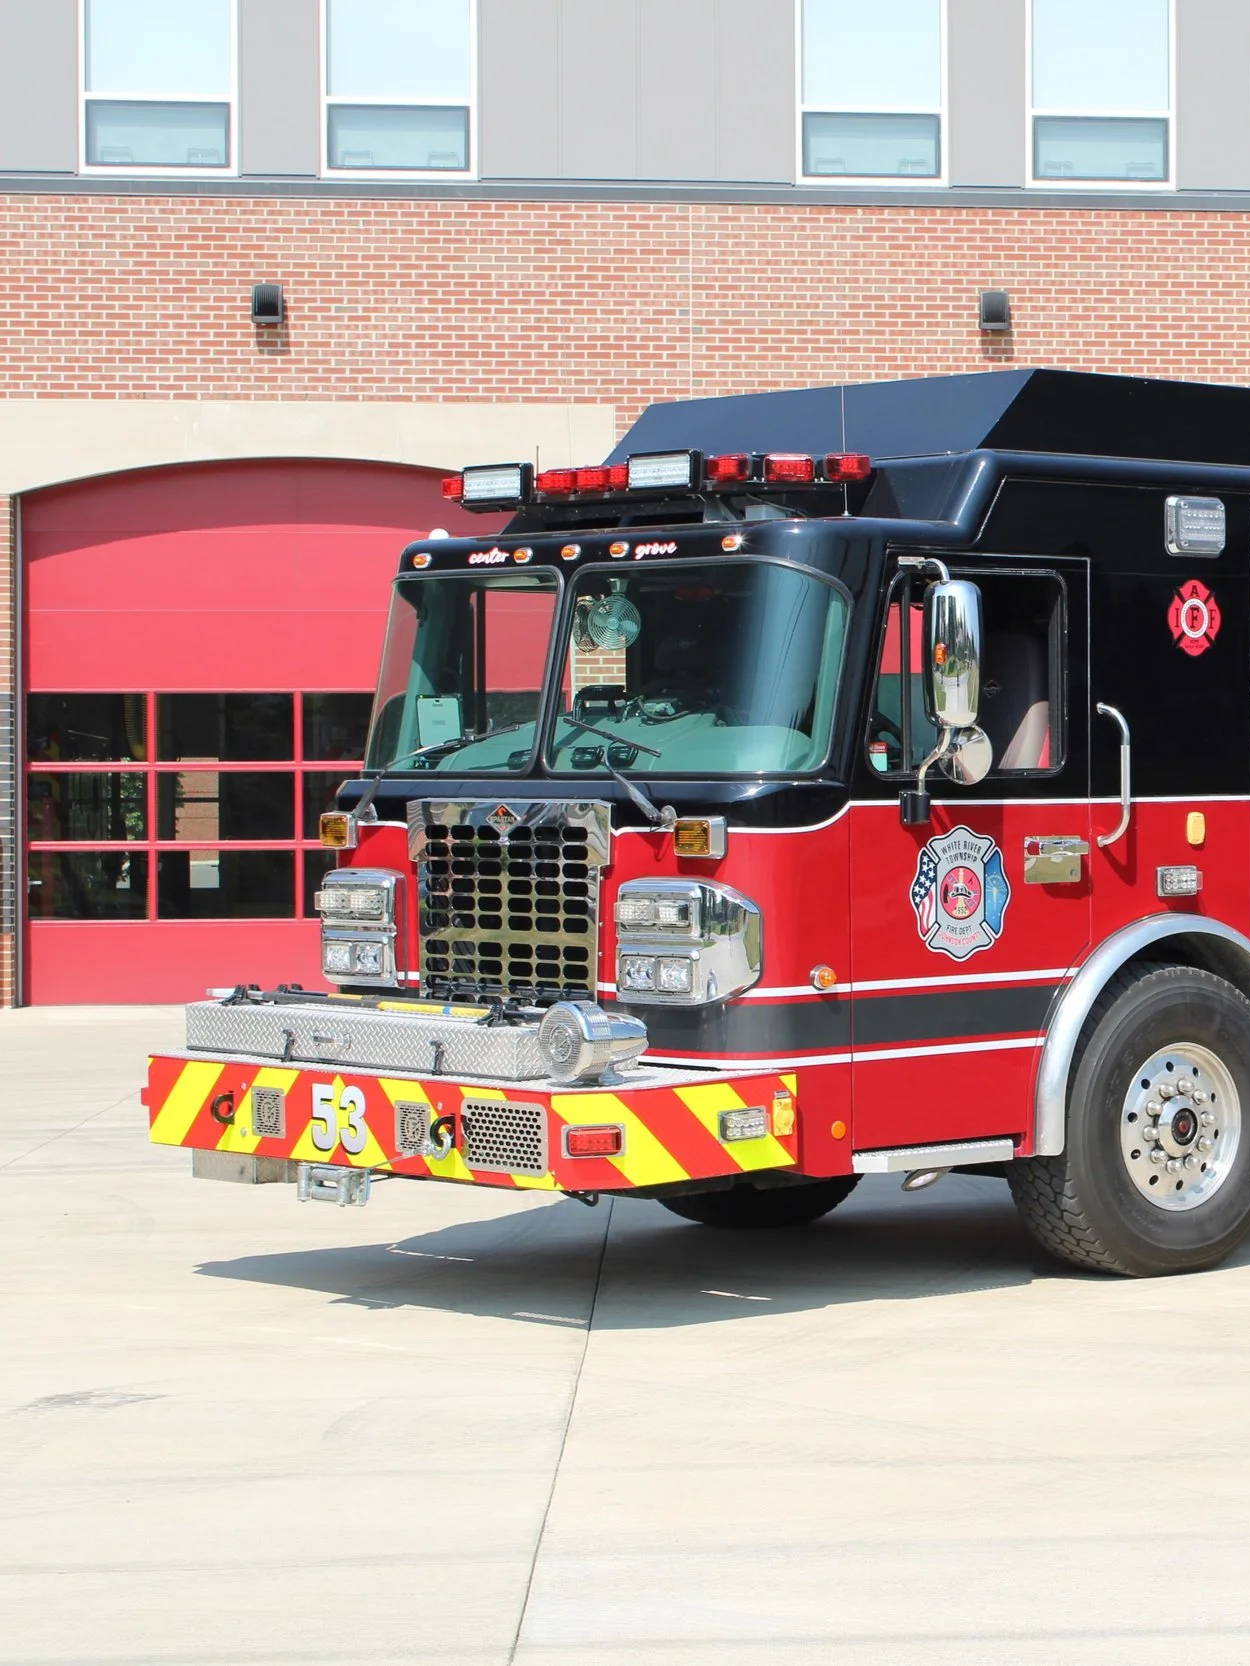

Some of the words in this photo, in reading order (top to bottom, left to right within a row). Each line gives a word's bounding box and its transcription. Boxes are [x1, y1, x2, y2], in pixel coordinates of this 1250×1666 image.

[468, 546, 509, 565] center
[634, 541, 678, 560] grove
[1189, 585, 1200, 598] A
[1190, 606, 1200, 629] F
[1208, 609, 1217, 629] F
[941, 841, 961, 855] WHITE
[963, 840, 982, 855] RIVER
[945, 852, 978, 865] TOWNSHIP
[946, 924, 958, 935] FIRE
[311, 1082, 368, 1155] 53
